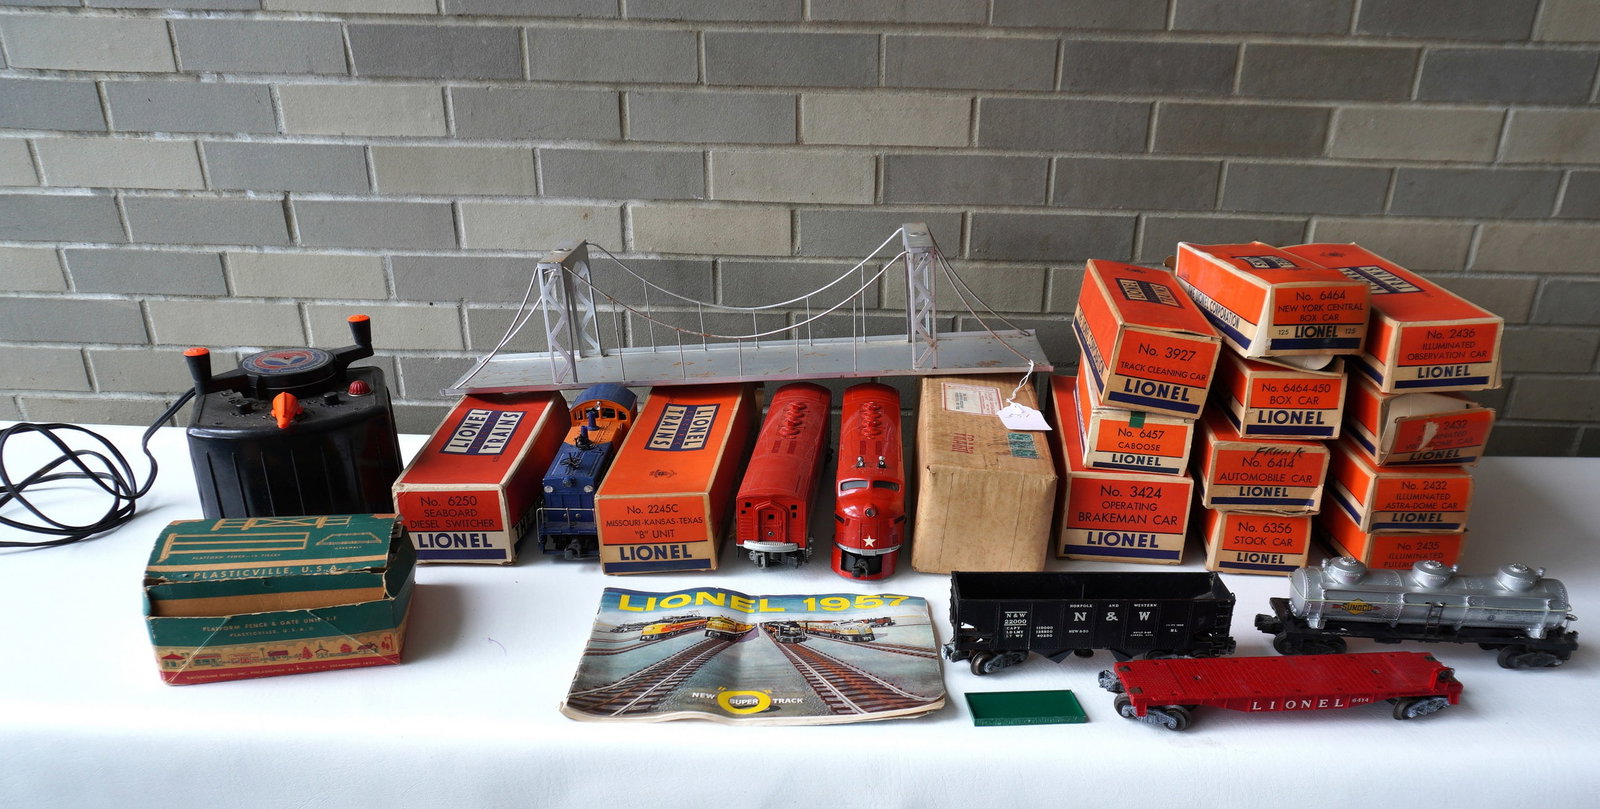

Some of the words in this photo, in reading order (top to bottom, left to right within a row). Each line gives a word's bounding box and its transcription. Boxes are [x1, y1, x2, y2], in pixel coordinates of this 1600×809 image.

[1296, 292, 1312, 301] No.
[1320, 290, 1346, 300] 6464
[1278, 304, 1298, 312] NEW
[1327, 303, 1364, 311] CENTRAL
[1209, 301, 1240, 329] CORPORATION
[1294, 326, 1338, 338] LIONEL
[1427, 330, 1444, 339] No.
[1449, 328, 1476, 338] 2436
[1422, 341, 1476, 350] ILLUMINATED
[1138, 344, 1158, 357] No.
[1165, 347, 1196, 362] 3927
[1408, 351, 1466, 361] OBSERVATION
[1120, 362, 1145, 372] TRACK
[1147, 366, 1187, 378] CLEANING
[1190, 371, 1206, 381] CAR
[1418, 366, 1471, 378] LIONEL
[1124, 379, 1190, 401] LIONEL
[1262, 384, 1279, 392] No.
[1283, 383, 1331, 393] 6464-450
[1270, 396, 1292, 404] BOX
[1297, 396, 1319, 405] CAR
[1258, 410, 1324, 425] LIONEL
[450, 412, 490, 448] LIONEL
[482, 414, 519, 450] TRAINS
[653, 410, 684, 445] TRAINS
[684, 410, 714, 446] LIONEL
[1118, 428, 1134, 438] No.
[1139, 430, 1165, 439] 6457
[1118, 442, 1160, 451] CABOOSE
[1112, 454, 1161, 466] LIONEL
[1409, 449, 1460, 460] LIONEL
[1242, 457, 1262, 467] No.
[1267, 457, 1295, 468] 6414
[1220, 472, 1286, 482] AUTOMOBILE
[1291, 474, 1312, 483] CAR
[1401, 482, 1418, 490] No.
[1423, 481, 1448, 490] 2432
[1100, 486, 1122, 497] No.
[1130, 486, 1162, 498] 3424
[1239, 486, 1289, 498] LIONEL
[420, 497, 440, 507] No.
[448, 496, 478, 506] 6250
[1101, 501, 1158, 511] OPERATING
[424, 510, 478, 518] SEABOARD
[627, 506, 643, 514] No.
[648, 504, 678, 514] 2245C
[1078, 512, 1147, 524] BRAKEMAN
[1153, 515, 1178, 526] CAR
[1391, 512, 1443, 522] LIONEL
[410, 520, 440, 529] DIESEL
[445, 519, 494, 528] SWITCHER
[1238, 522, 1257, 532] No.
[1263, 523, 1292, 534] 6356
[652, 529, 675, 538] UNIT
[418, 533, 492, 548] LIONEL
[1086, 531, 1159, 548] LIONEL
[1234, 536, 1267, 546] STOCK
[1272, 537, 1293, 547] CAR
[1416, 542, 1440, 550] 2435
[620, 544, 692, 560] LIONEL
[1237, 552, 1285, 564] LIONEL
[618, 592, 785, 613] LIONEL
[802, 596, 909, 612] 1957
[1342, 602, 1373, 611] SUNOCO
[1074, 612, 1087, 621] N
[1106, 612, 1119, 621] &
[1139, 612, 1151, 621] W
[1252, 698, 1344, 710] LIONEL
